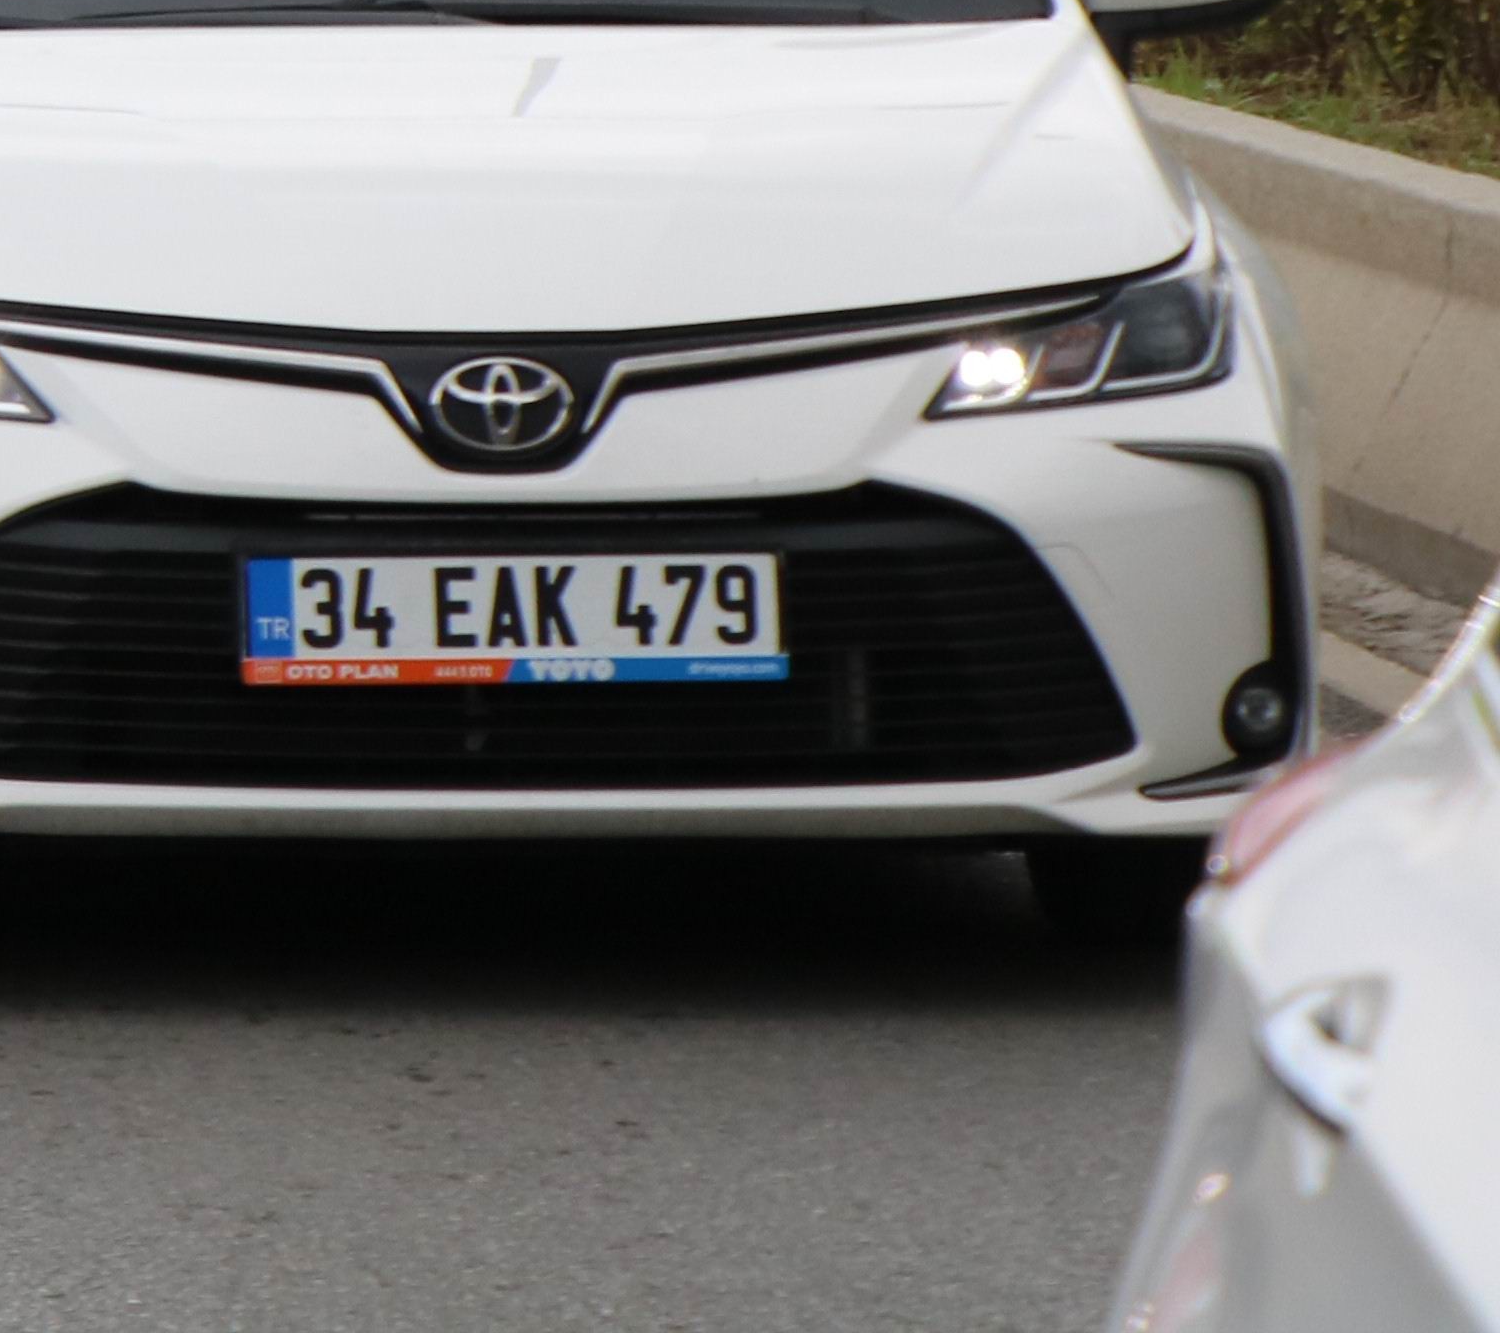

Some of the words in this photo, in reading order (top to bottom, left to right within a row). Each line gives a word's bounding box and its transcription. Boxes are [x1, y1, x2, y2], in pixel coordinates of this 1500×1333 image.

[301, 566, 395, 650] 34
[432, 564, 577, 648] EAK
[615, 563, 760, 647] 479
[257, 616, 290, 640] TR
[286, 665, 333, 679] OTO
[339, 664, 399, 679] PLAN
